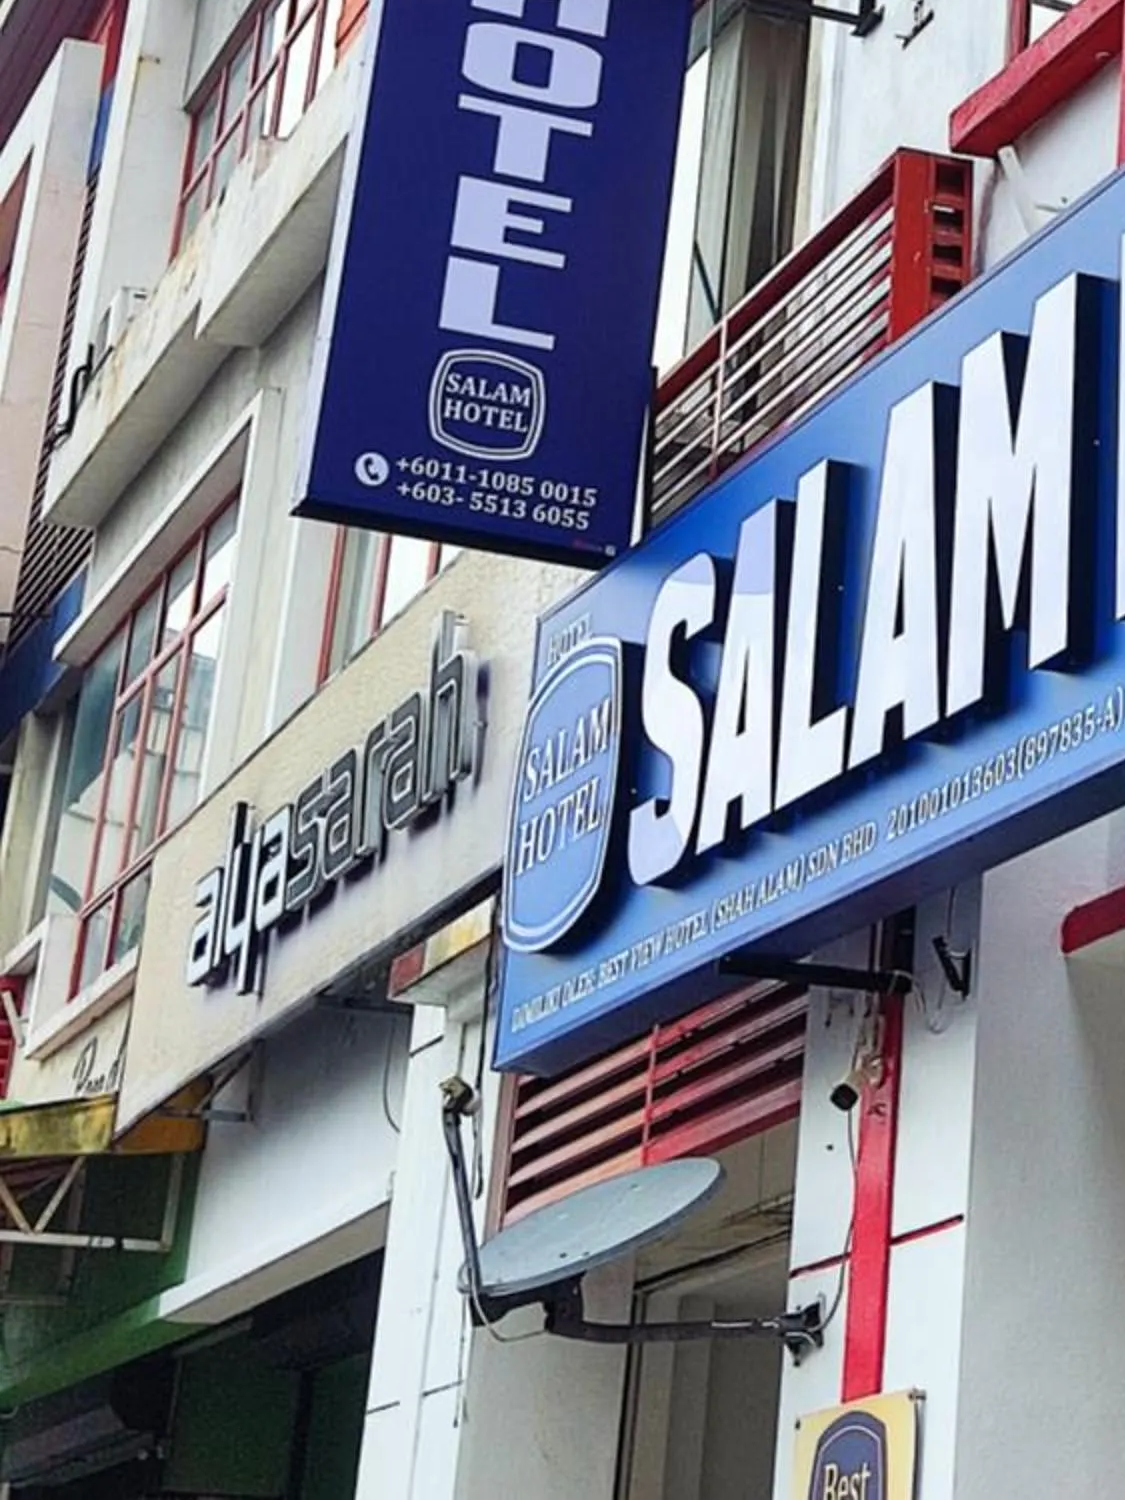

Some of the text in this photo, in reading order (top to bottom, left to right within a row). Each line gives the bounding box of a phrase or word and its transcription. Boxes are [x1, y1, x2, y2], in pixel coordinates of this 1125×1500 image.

[443, 398, 529, 433] HOTEL
[445, 372, 532, 408] SALAM
[395, 455, 598, 508] +6011-1085 0015
[396, 481, 590, 531] +603- 5513 6055
[627, 272, 1085, 888] SALAM
[523, 696, 611, 804] SALAM
[513, 776, 602, 878] HOTEL
[664, 907, 708, 956] HOTEL
[806, 837, 840, 883] SDN
[840, 821, 878, 867] BHD
[823, 1462, 872, 1500] Best
